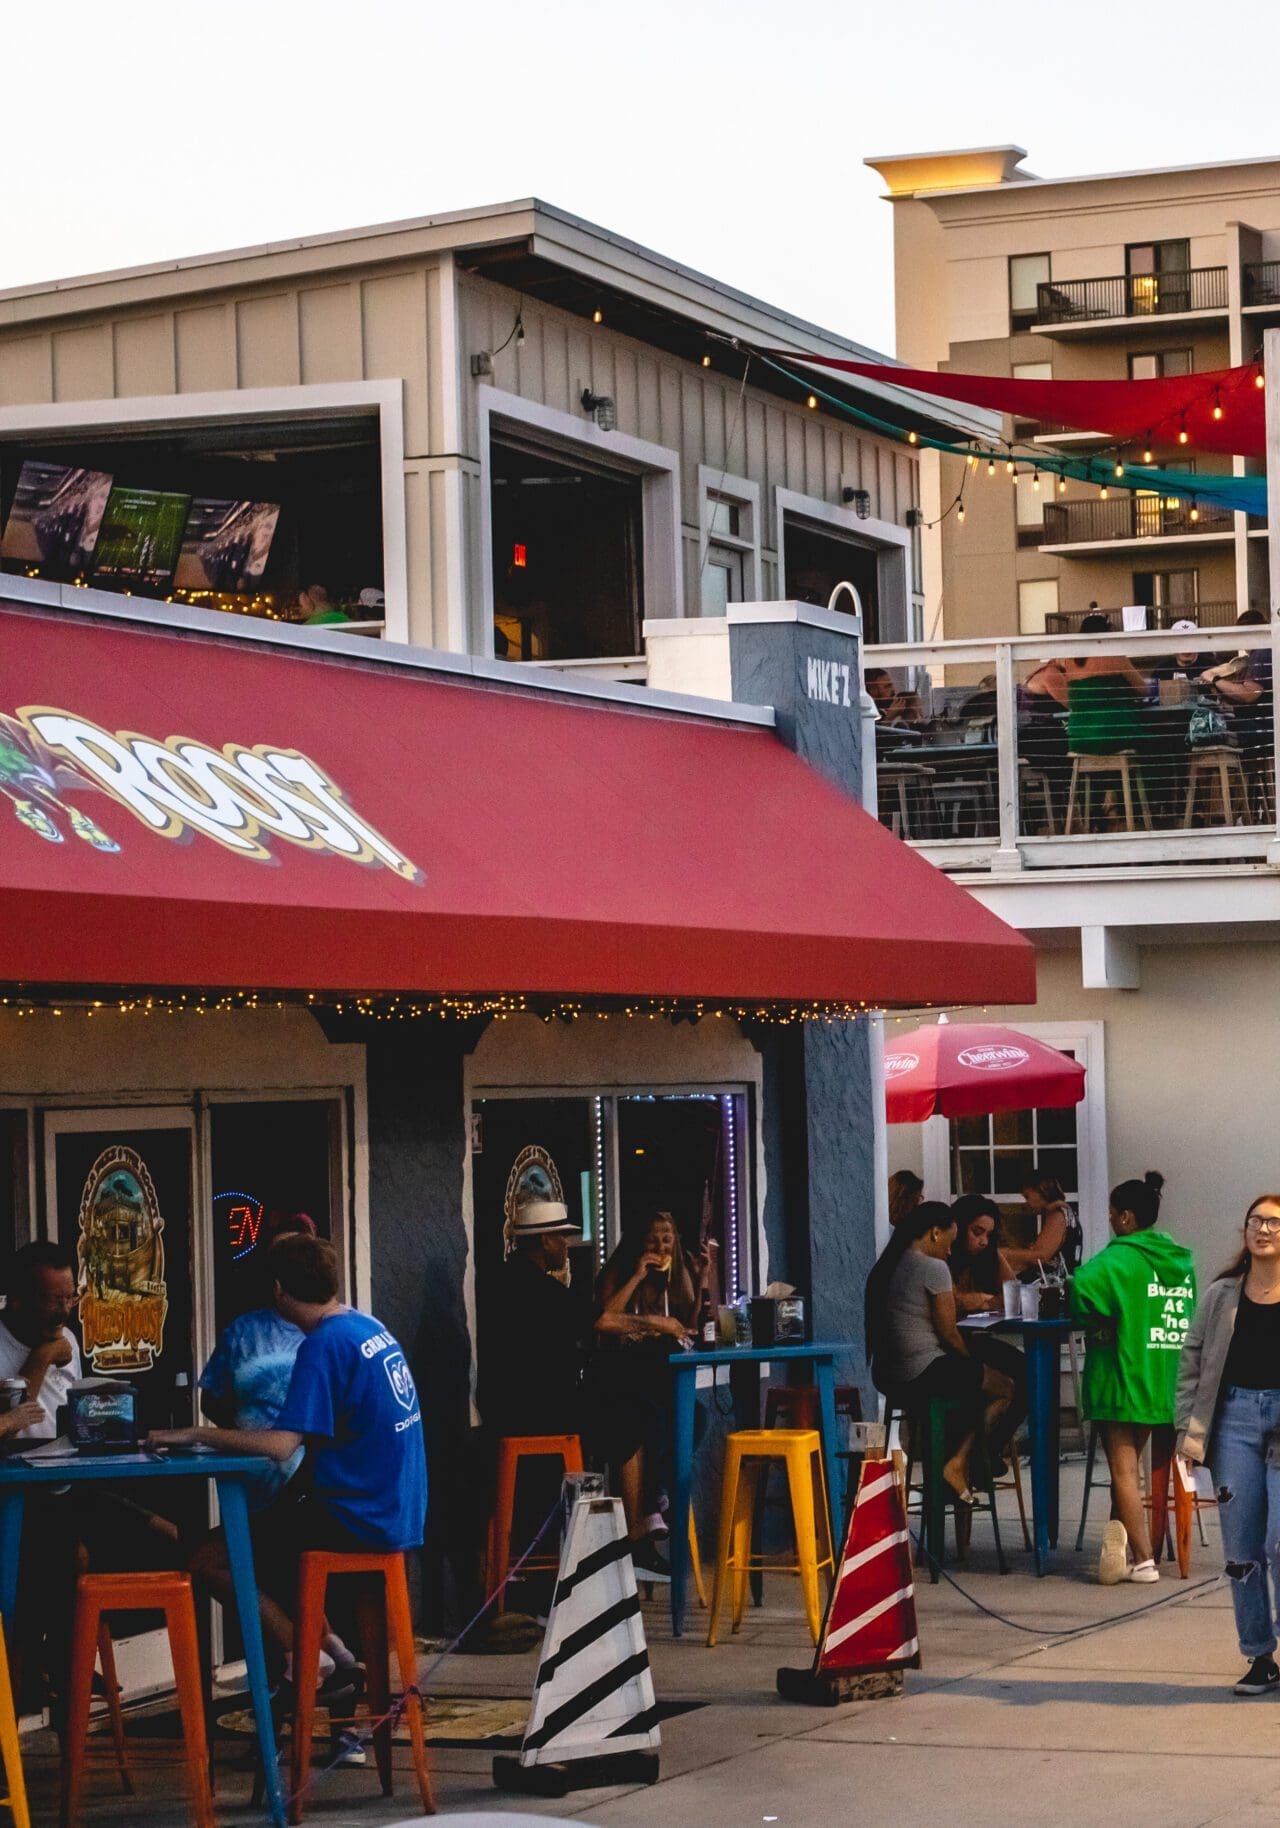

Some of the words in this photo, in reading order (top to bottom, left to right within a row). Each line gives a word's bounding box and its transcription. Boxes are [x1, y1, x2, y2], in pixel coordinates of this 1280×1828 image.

[22, 708, 412, 876] ROOST
[958, 1047, 1029, 1066] Cheerwine
[1163, 1298, 1184, 1313] At
